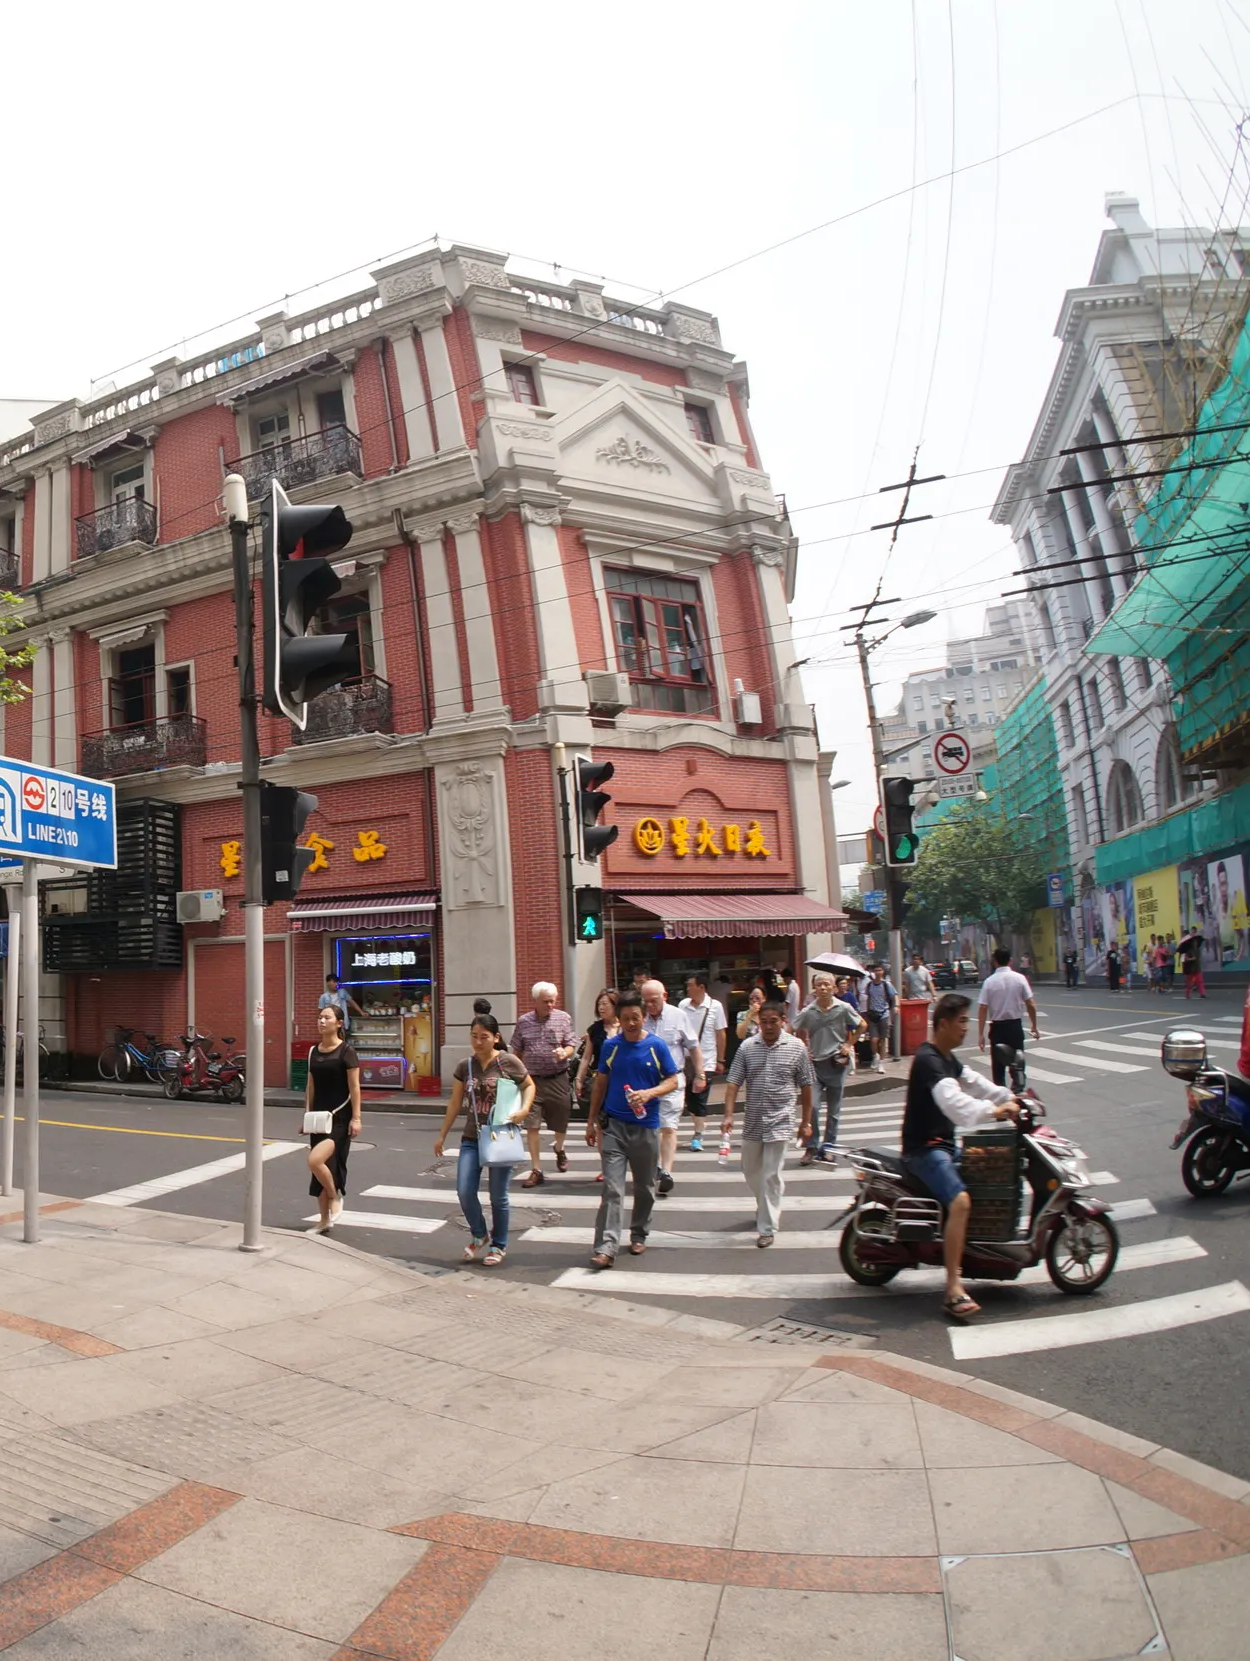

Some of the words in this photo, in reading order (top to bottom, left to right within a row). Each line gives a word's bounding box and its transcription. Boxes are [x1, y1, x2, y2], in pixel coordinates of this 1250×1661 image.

[62, 789, 73, 811] 10
[75, 788, 108, 822] 号线
[220, 830, 389, 878] 星食品
[351, 951, 417, 967] 上海老酸奶
